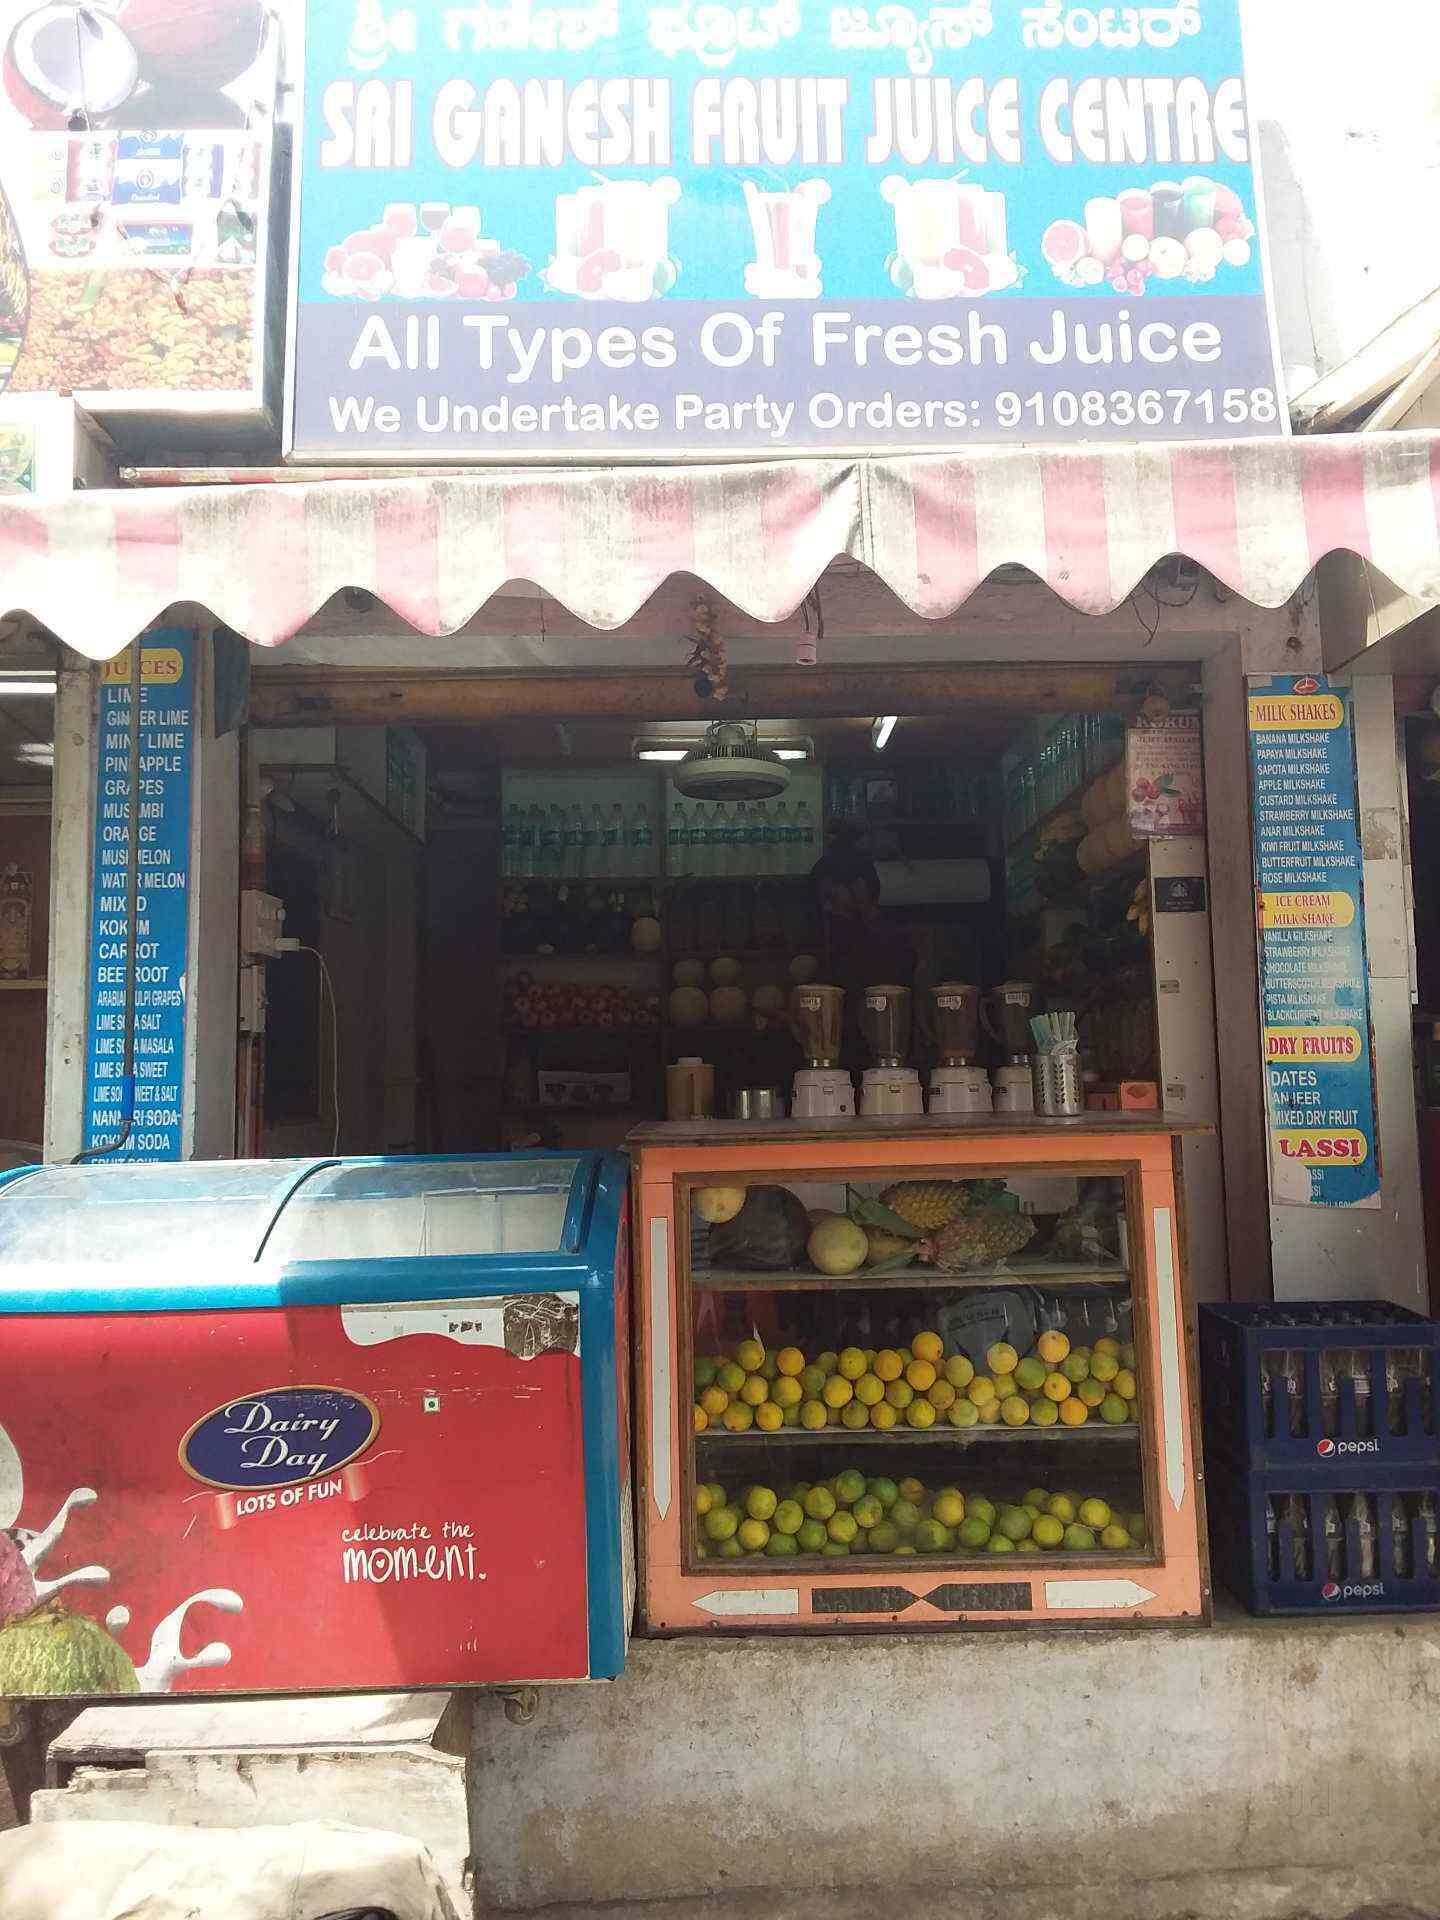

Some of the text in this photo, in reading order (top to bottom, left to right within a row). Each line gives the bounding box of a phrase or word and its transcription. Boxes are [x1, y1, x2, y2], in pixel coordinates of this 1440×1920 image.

[319, 76, 1250, 168] SRI GANESH FRUIT JUICE CENTRE
[348, 309, 1223, 383] All Types Of Fresh Juice
[328, 387, 1277, 438] We Undertake Party Orders: 9108367158
[103, 661, 178, 679] JUCES
[107, 710, 189, 726] GINER LIME
[1256, 703, 1336, 721] MILK SHAKES
[148, 732, 184, 748] LIME
[1256, 733, 1330, 744] BANANA MILKSHAKE
[1257, 748, 1328, 760] PAPAYA MILKSHAKE
[105, 756, 182, 772] PINAPPLE
[1258, 763, 1330, 775] SAPOTA MILKSHAKE
[105, 779, 164, 795] GRPES
[1259, 778, 1326, 791] APPLE MILKSHAKE
[1260, 793, 1337, 806] CUSTARD MILKSHAKE
[104, 802, 165, 818] MUSMBI
[1260, 809, 1353, 821] STRAWBERRY MILKSHAKE
[103, 826, 157, 842] ORAGE
[1261, 825, 1325, 837] ANAR MILKSHAKE
[1280, 841, 1301, 852] FRUIT
[1302, 840, 1345, 851] MILKSHAKE
[1262, 856, 1356, 868] BUTTERFRUIT MILKSHAKE
[102, 872, 185, 889] WATR MELON
[1263, 872, 1328, 884] ROSE MILKSHAKE
[101, 895, 147, 911] MIXD
[1276, 895, 1331, 907] ICE CREAM
[99, 919, 150, 936] KOKM
[1273, 914, 1297, 925] MILK
[98, 966, 169, 983] BEEROOT
[97, 990, 127, 1006] ARABIA
[152, 990, 182, 1007] GRAPES
[96, 1014, 115, 1031] LIME
[141, 1014, 162, 1031] SALT
[95, 1038, 115, 1054] LIME
[140, 1037, 174, 1054] MASALA
[1269, 1036, 1355, 1055] DRY FRUITS
[94, 1062, 114, 1078] LIME
[140, 1061, 169, 1078] SWEET
[1271, 1070, 1318, 1086] DATES
[93, 1086, 110, 1102] LIME
[134, 1086, 153, 1102] WEET
[161, 1086, 178, 1102] SALT
[147, 1109, 178, 1126] SODA
[1306, 1110, 1327, 1126] DRY
[1329, 1110, 1359, 1126] FRUIT
[137, 1133, 170, 1150] SODA
[1279, 1138, 1361, 1158] LASSI
[224, 1400, 341, 1441] Dairy
[1337, 1439, 1380, 1455] pepsi
[240, 1435, 328, 1476] Day
[236, 1478, 345, 1516] LOTS OF FUN
[342, 1521, 475, 1542] celebrate the
[1343, 1583, 1384, 1600] pepsi
